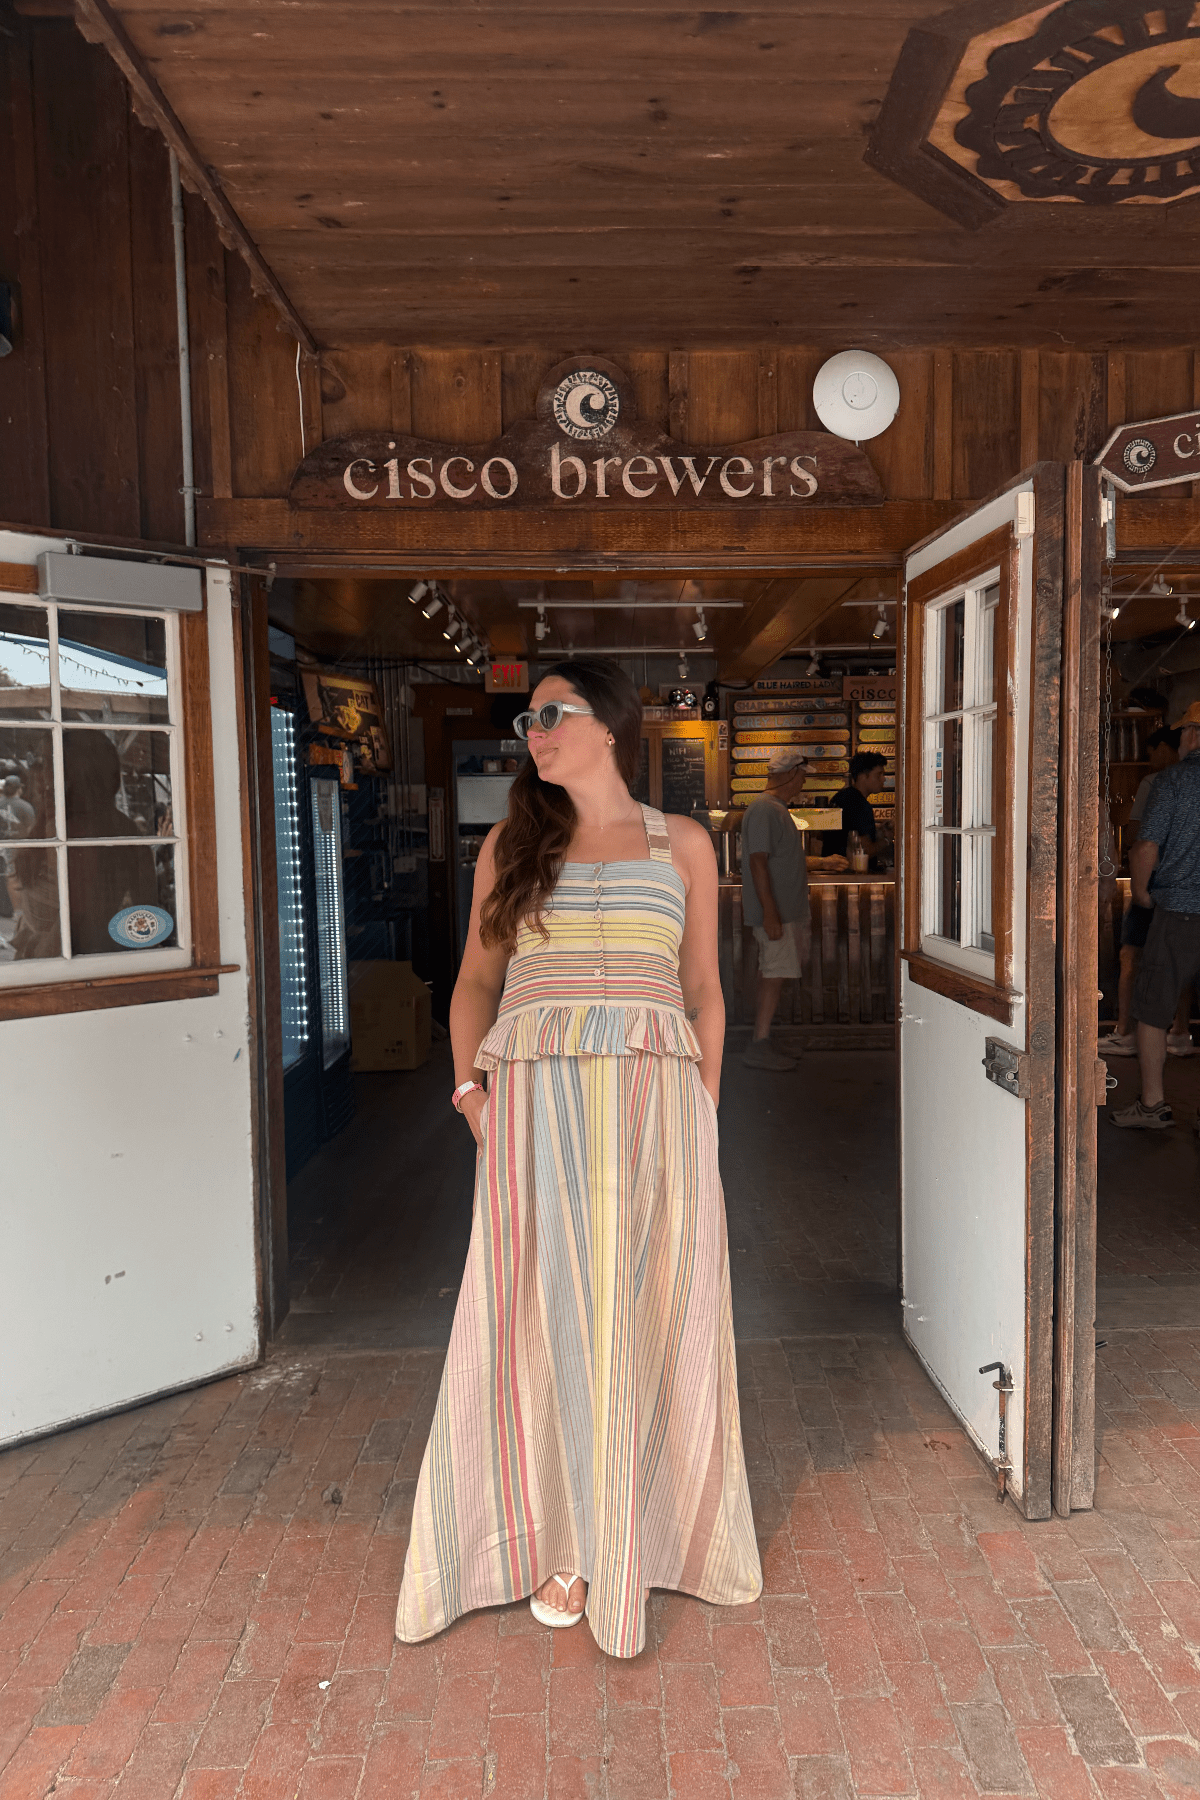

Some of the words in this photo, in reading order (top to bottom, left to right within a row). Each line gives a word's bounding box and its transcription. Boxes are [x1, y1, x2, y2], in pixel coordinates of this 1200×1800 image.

[343, 441, 519, 500] cisco
[548, 441, 819, 499] brewers
[492, 664, 523, 688] EXIT
[757, 681, 778, 690] BLUE
[780, 681, 811, 690] HAIRED
[813, 680, 836, 689] LADY
[736, 717, 770, 729] GREY
[774, 716, 806, 727] LADY
